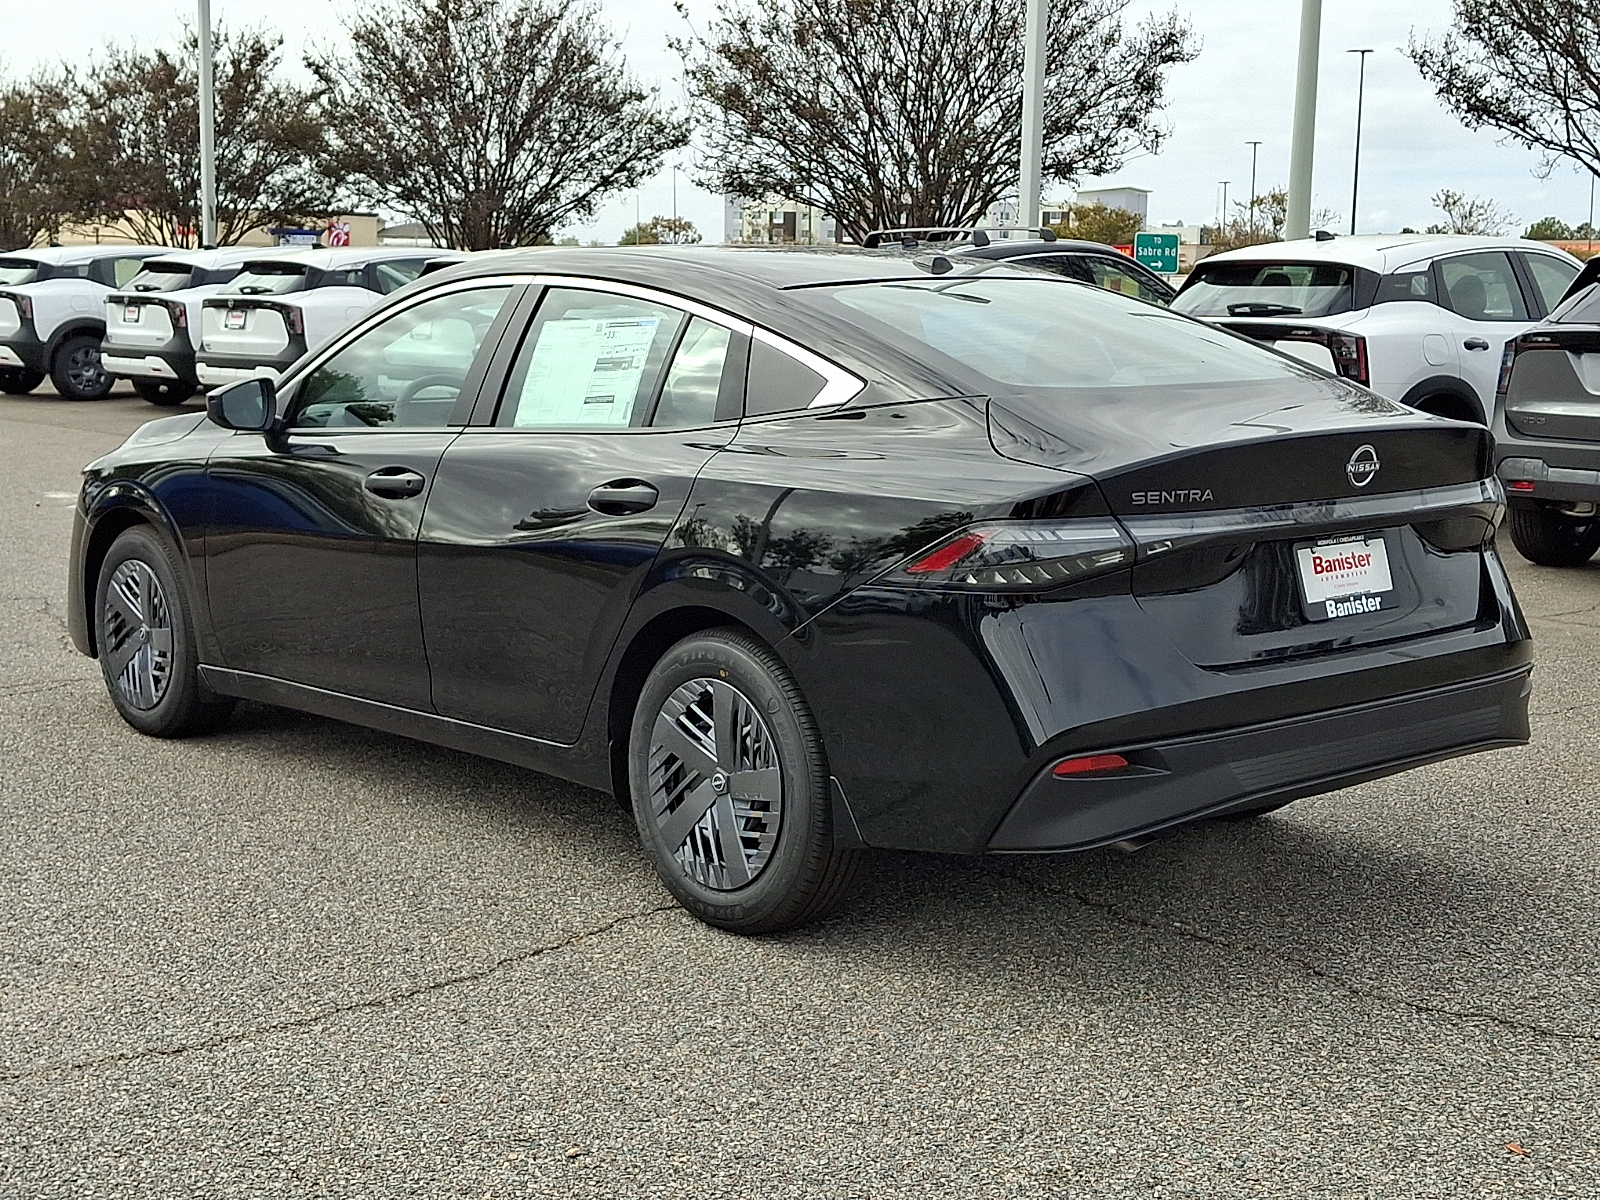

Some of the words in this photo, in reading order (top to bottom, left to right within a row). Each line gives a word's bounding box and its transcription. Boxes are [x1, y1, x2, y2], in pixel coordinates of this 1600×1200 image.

[1153, 236, 1162, 244] TO
[1137, 246, 1162, 256] Sabre
[1164, 246, 1176, 257] Rd
[1347, 460, 1380, 473] NISSAN
[1131, 489, 1214, 505] SENTRA
[1312, 551, 1372, 575] Banister
[1320, 570, 1367, 582] AUTOMOTIVE
[1325, 595, 1382, 619] Banister
